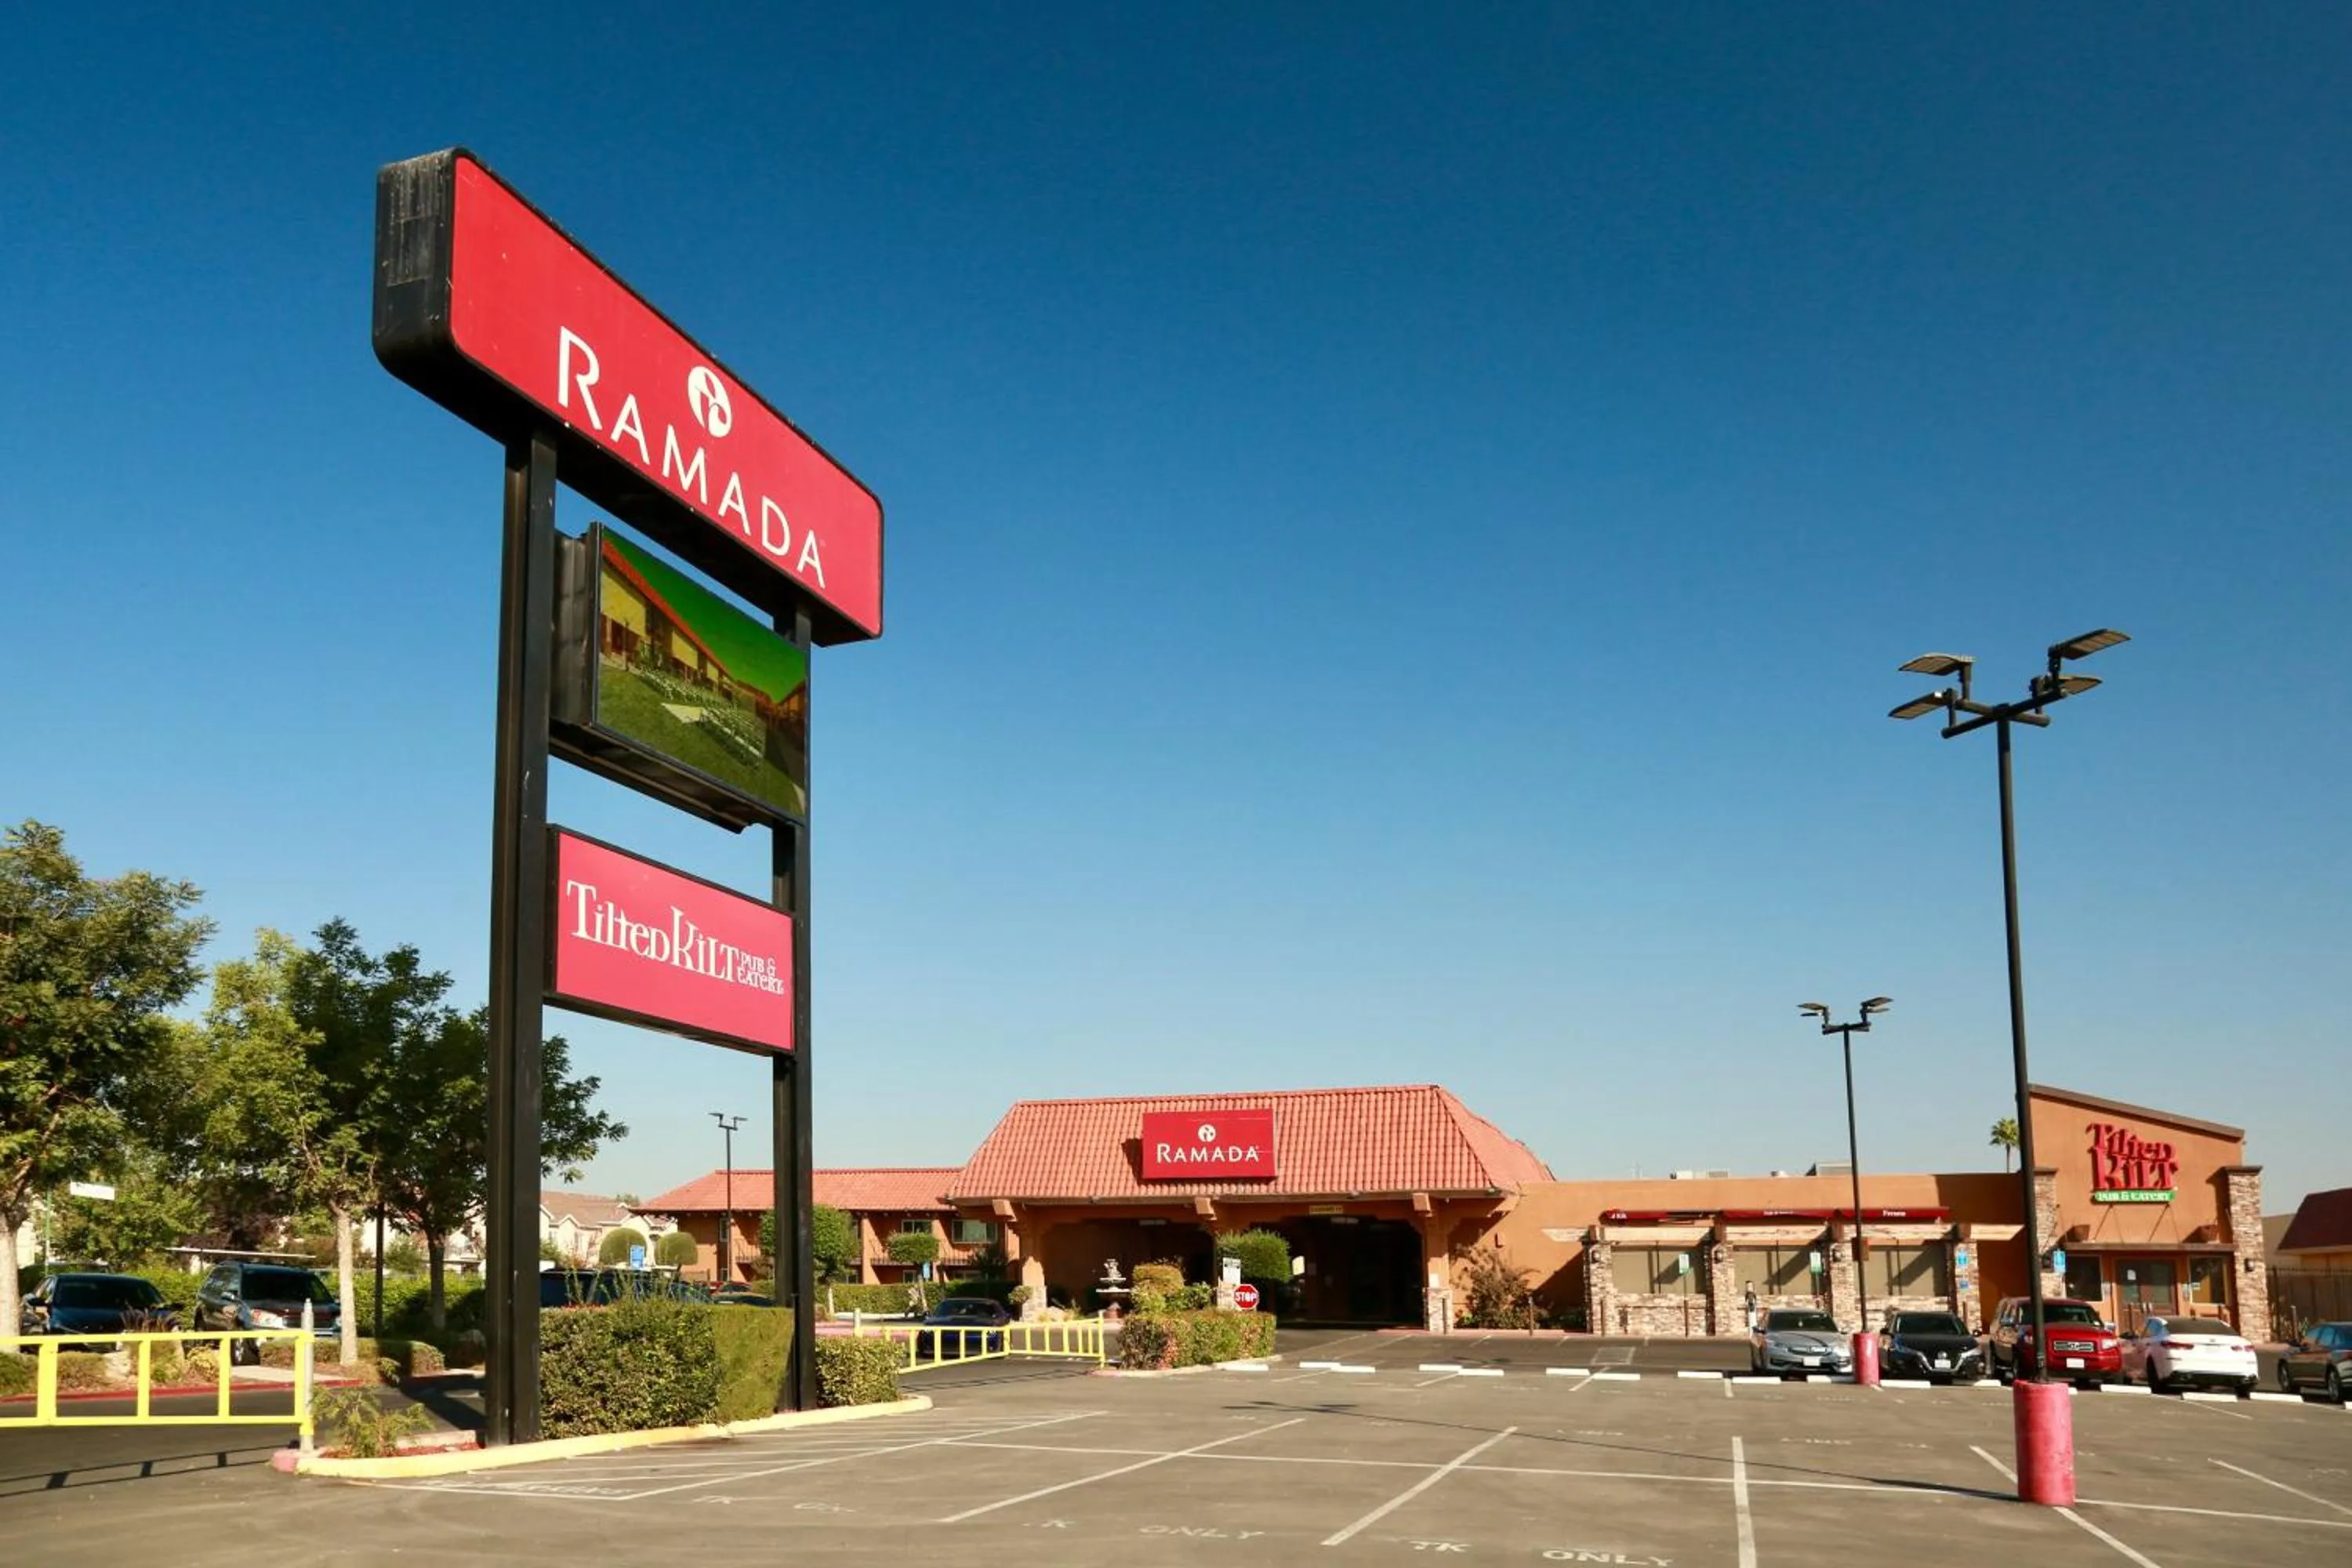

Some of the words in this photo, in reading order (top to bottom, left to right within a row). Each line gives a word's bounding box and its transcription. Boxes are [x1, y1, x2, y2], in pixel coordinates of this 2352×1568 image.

[557, 325, 826, 590] RAMADA
[739, 950, 765, 974] PUB
[1156, 1142, 1260, 1164] RAMADA
[1235, 1291, 1256, 1302] STOP
[1541, 1548, 1674, 1567] ONLY
